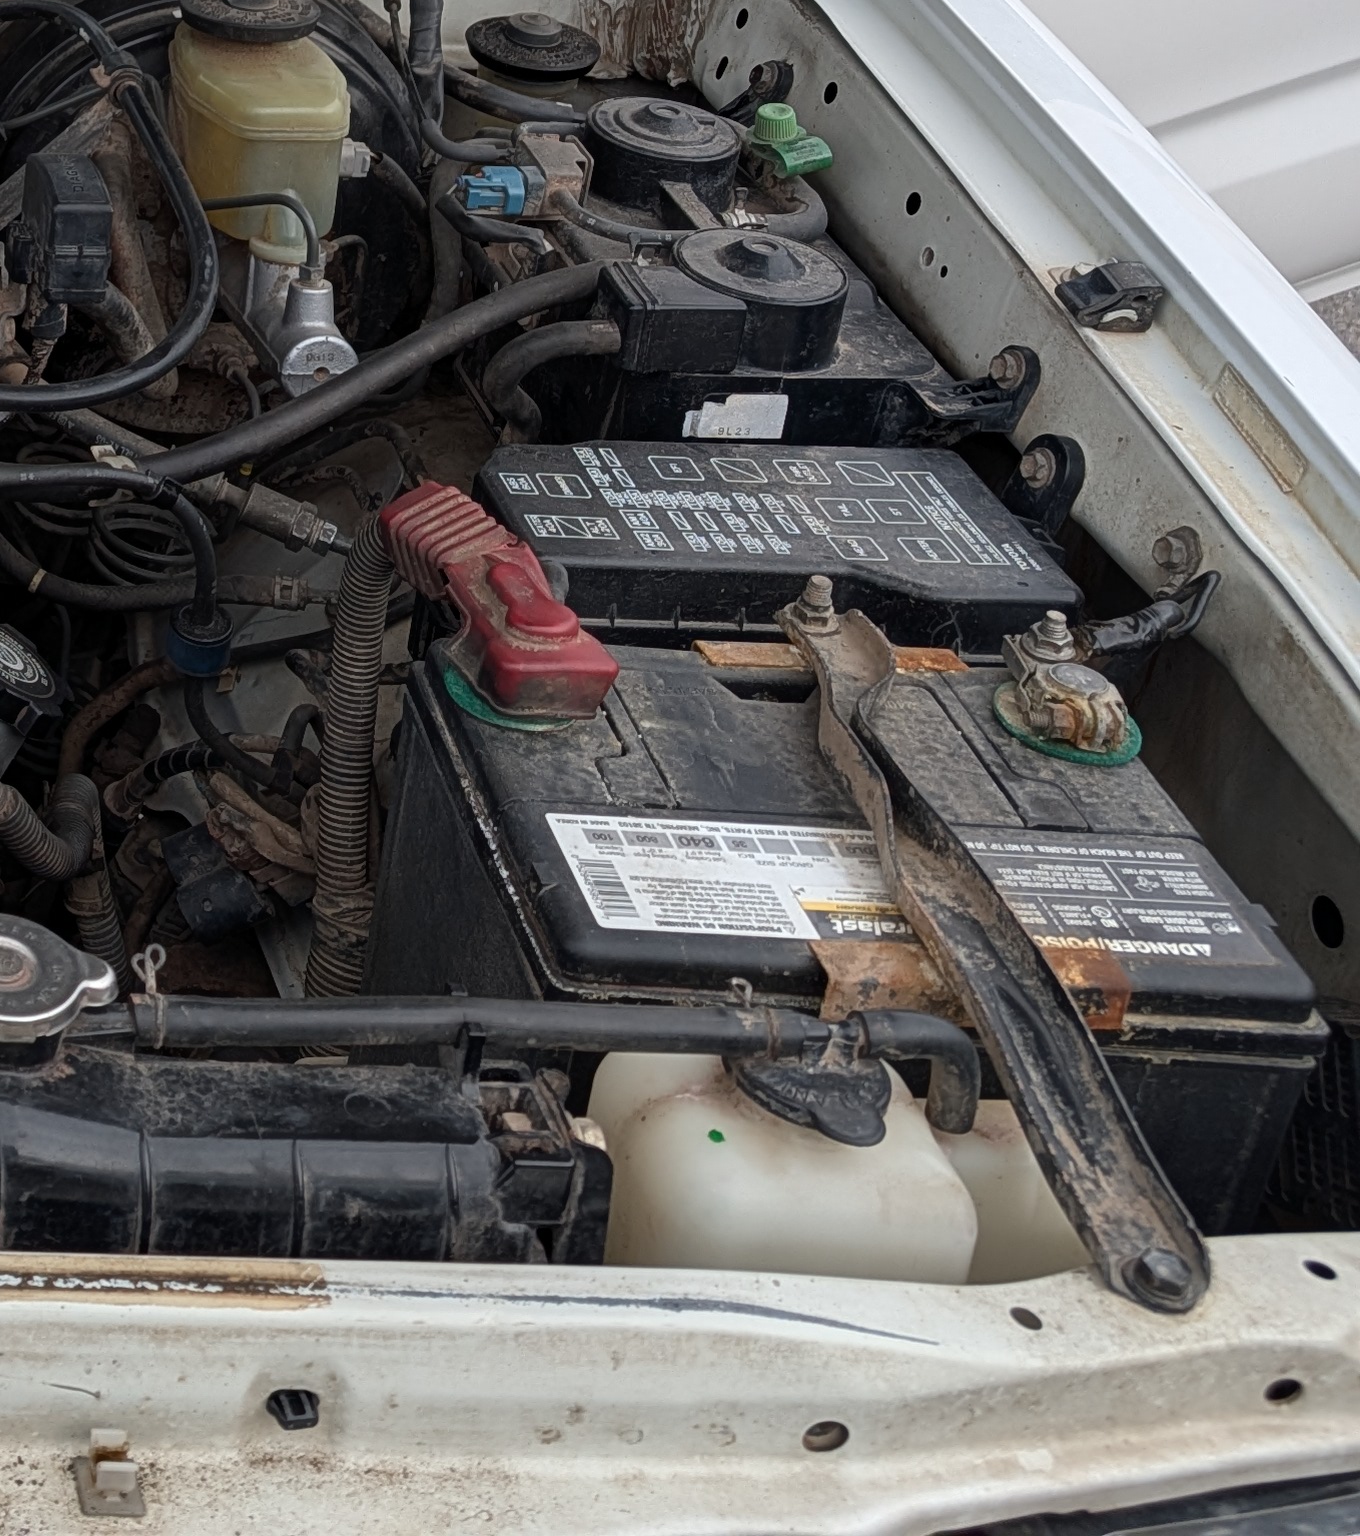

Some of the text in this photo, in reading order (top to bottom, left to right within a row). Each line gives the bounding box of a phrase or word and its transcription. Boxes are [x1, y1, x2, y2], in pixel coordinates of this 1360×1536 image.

[717, 426, 752, 436] 9L23
[835, 502, 854, 517] TAIL
[888, 506, 903, 515] ST
[923, 505, 953, 530] NOTICE
[584, 521, 600, 534] ALT
[846, 539, 867, 556] HEAD
[915, 539, 940, 560] HEATER
[999, 542, 1031, 570] TOYOTA
[591, 832, 613, 840] 100
[676, 835, 715, 847] 640
[1034, 845, 1078, 854] CHILDREN.
[1088, 848, 1117, 856] REACH
[1162, 851, 1184, 860] KEEP
[717, 924, 782, 932] PROPOSITION
[1099, 918, 1119, 928] NO
[1162, 924, 1184, 932] EYES
[1032, 934, 1200, 956] DANGER/POISO
